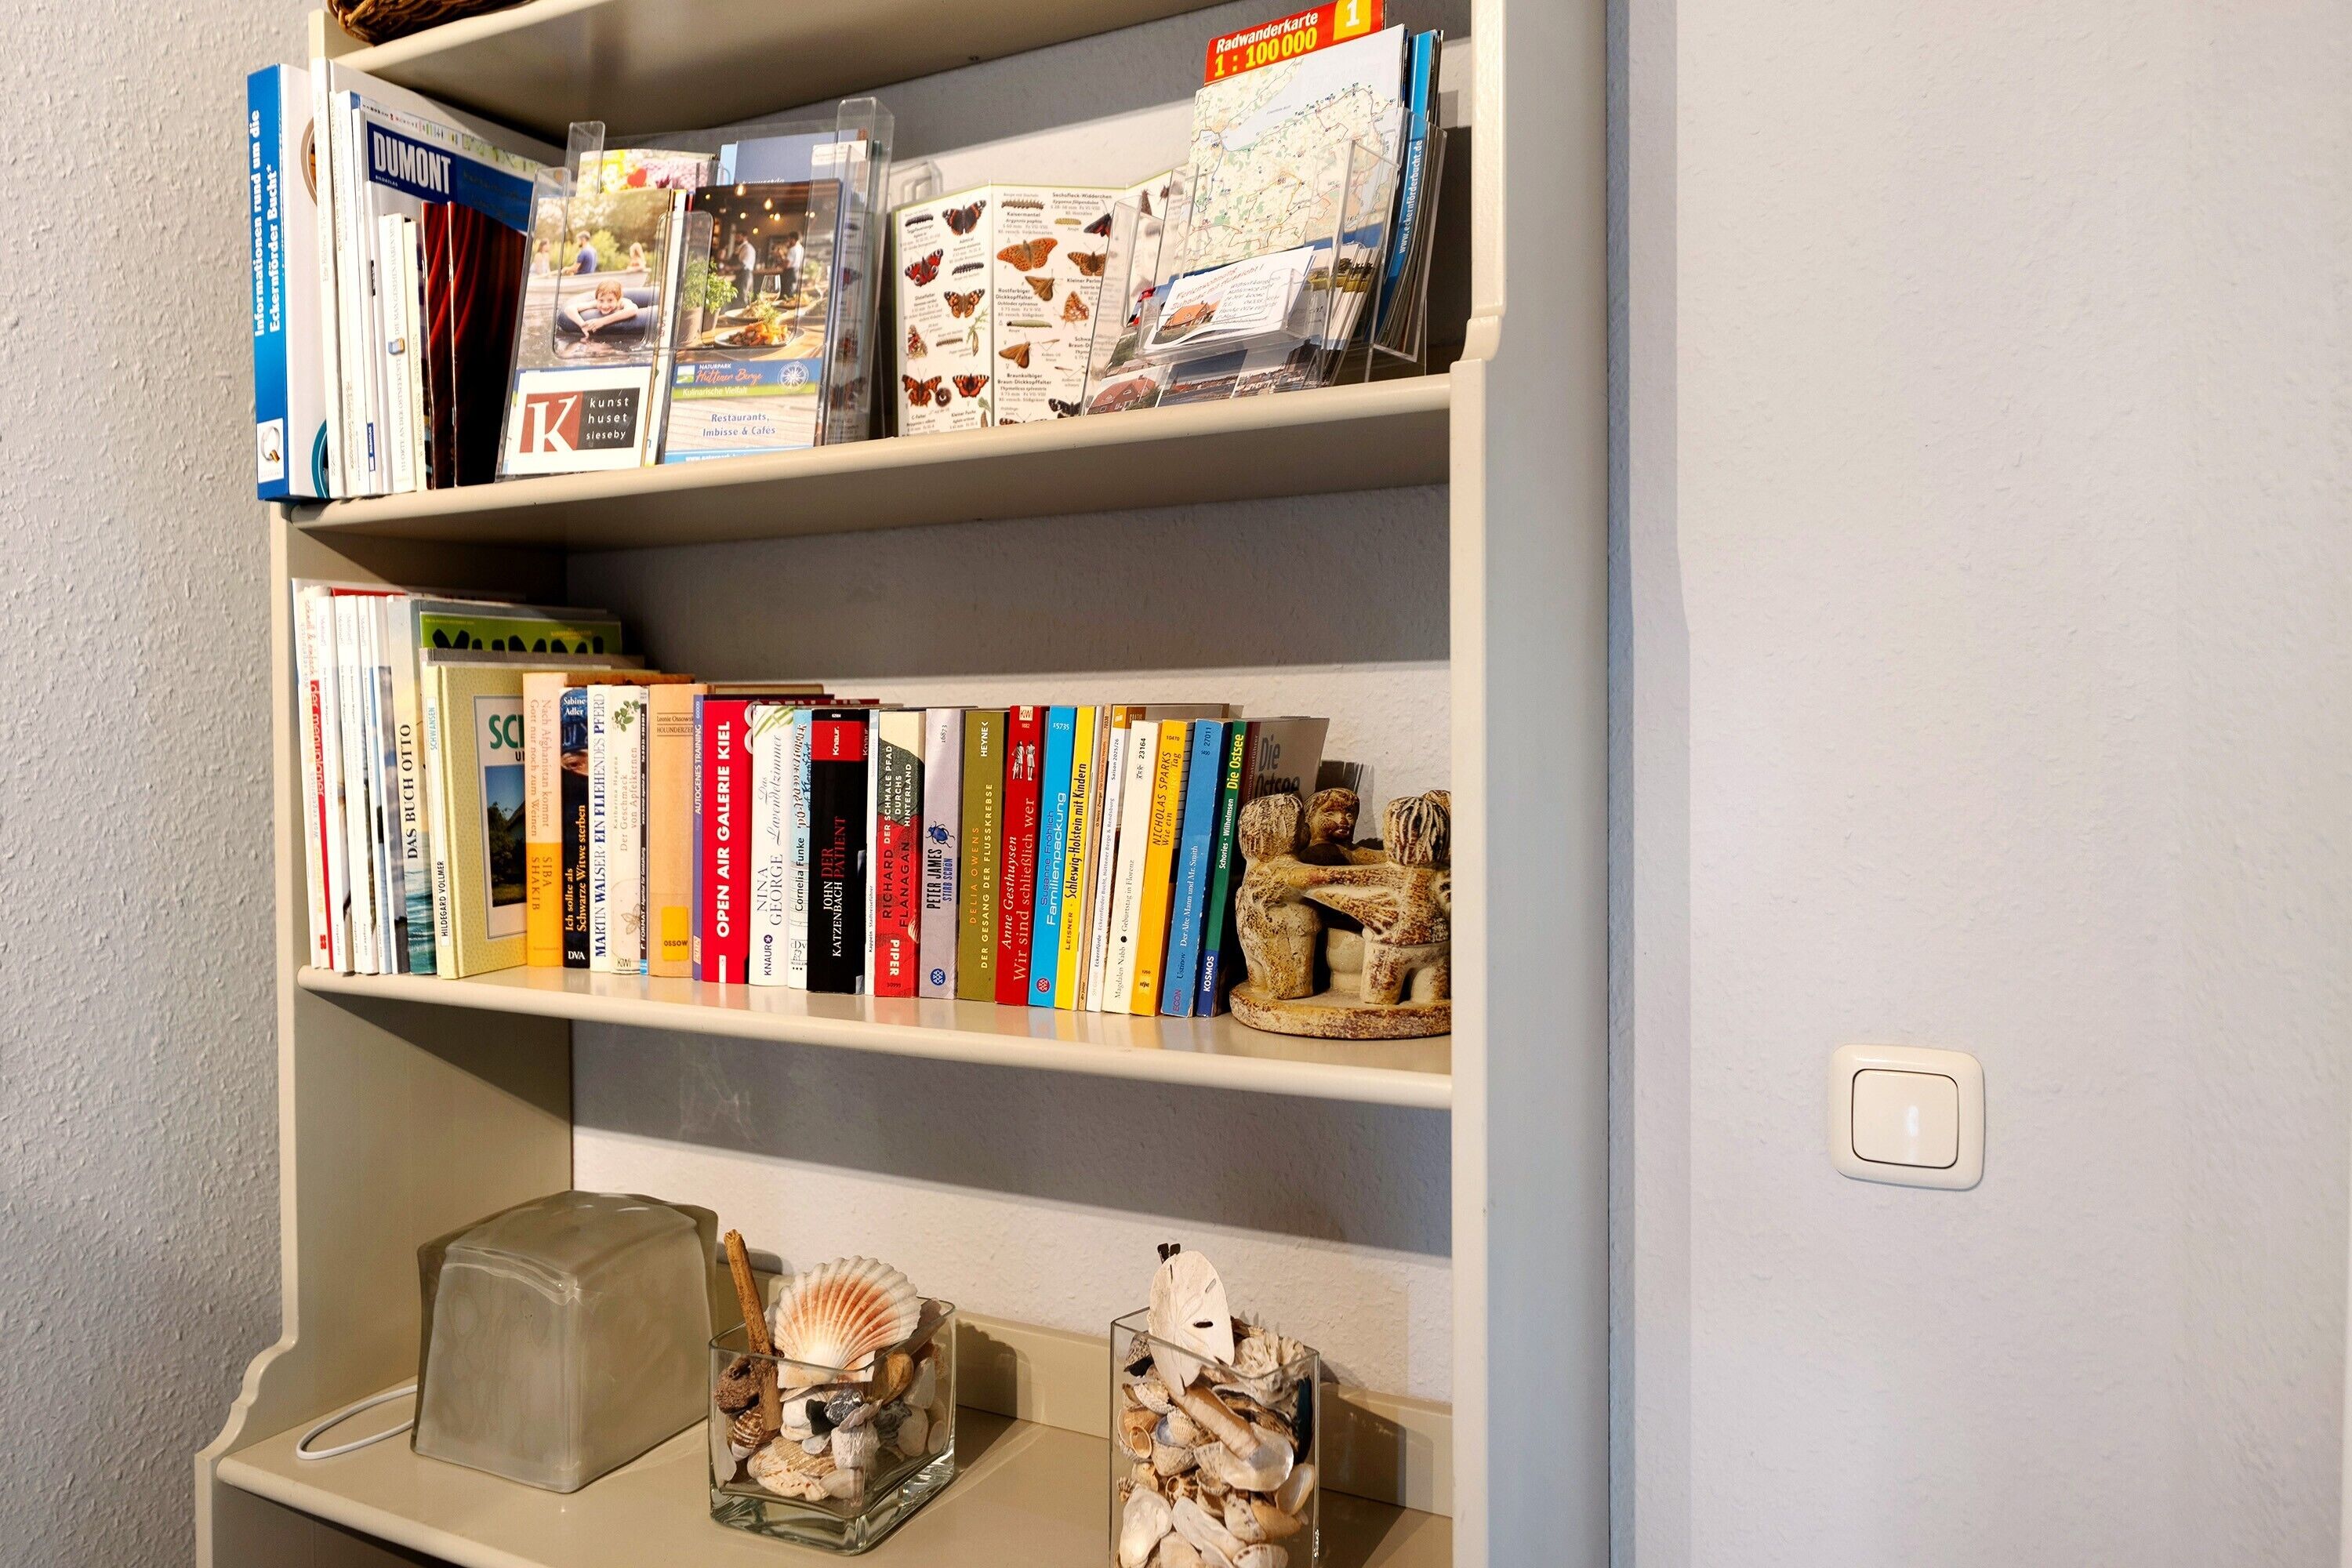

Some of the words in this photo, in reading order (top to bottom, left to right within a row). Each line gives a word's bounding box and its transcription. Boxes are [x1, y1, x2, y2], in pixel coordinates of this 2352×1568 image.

[1345, 0, 1359, 27] 1
[1216, 11, 1318, 53] Radwanderkarte
[1214, 54, 1225, 77] 1
[1246, 37, 1279, 68] 100
[1282, 27, 1318, 57] 000
[249, 110, 260, 137] die
[251, 141, 261, 169] um
[373, 131, 451, 194] DUMONT
[251, 172, 263, 212] rund
[376, 176, 397, 187] BILDATLAS
[1399, 140, 1422, 253] www.eckernförderbucht.de
[252, 216, 264, 336] Informationen
[266, 223, 281, 332] Eckernförder
[589, 412, 627, 423] huset
[590, 396, 629, 408] kunst
[711, 413, 770, 423] Restaurants,
[527, 395, 579, 455] K
[586, 430, 626, 441] sieseby
[703, 427, 738, 437] Imbisse
[428, 706, 438, 750] SCHWANSEN
[530, 700, 539, 722] Gott
[542, 699, 551, 724] Nach
[593, 694, 604, 735] PFERD
[399, 724, 413, 771] OTTO
[539, 728, 552, 788] Afghanistan
[717, 720, 730, 760] KIEL
[1228, 735, 1243, 768] Ostsee
[1258, 734, 1280, 771] Die
[530, 747, 539, 771] noch
[593, 738, 604, 816] FLIEHENDES
[629, 747, 638, 807] Apfelkernen
[1158, 751, 1171, 789] SPARKS
[757, 776, 768, 804] Das
[767, 735, 782, 846] Lavendelzimmer
[1073, 764, 1087, 798] Kindern
[1226, 771, 1240, 789] Die
[402, 778, 416, 822] BUCH
[542, 791, 552, 827] kommt
[620, 775, 629, 829] Geschmack
[717, 765, 730, 841] GALERIE
[1024, 797, 1034, 827] wer
[1073, 800, 1083, 815] mit
[1161, 829, 1171, 846] Wie
[1171, 753, 1181, 768] Tag
[1222, 798, 1234, 837] Wilhelmsen
[531, 799, 539, 837] Weinen
[576, 804, 586, 843] sterben
[595, 821, 605, 843] EIN
[983, 784, 993, 862] FLUSSKREBSE
[1044, 811, 1054, 854] Fröhlich
[1152, 794, 1167, 845] NICHOLAS
[405, 827, 418, 859] DAS
[797, 837, 805, 866] Funke
[834, 815, 846, 877] PATIENT
[1047, 792, 1066, 926] Familienpackung
[1065, 818, 1083, 899] Schleswig-Holstein
[1188, 846, 1198, 866] Smith
[1218, 843, 1228, 869] Schories
[437, 861, 446, 894] VOLLMER
[542, 857, 553, 887] SIBA
[565, 868, 574, 882] als
[576, 846, 586, 880] Witwe
[595, 850, 606, 903] WALSER
[717, 847, 730, 880] AIR
[822, 848, 833, 877] DER
[927, 848, 942, 879] JAMES
[942, 858, 953, 880] SCHÖN
[1004, 836, 1017, 911] Gesthuysen
[1020, 833, 1033, 905] schließlich
[1125, 859, 1134, 885] Florenz
[565, 885, 574, 910] sollte
[757, 868, 768, 913] NINA
[771, 854, 782, 926] GEORGE
[796, 870, 804, 911] Cornelia
[823, 881, 833, 909] JOHN
[881, 849, 894, 919] RICHARD
[898, 842, 910, 928] FLANAGAN
[927, 882, 941, 909] PETER
[942, 882, 952, 902] STIRB
[1040, 858, 1051, 906] Susanne
[438, 896, 448, 936] HILDEGARD
[565, 914, 574, 931] Ich
[575, 883, 586, 931] Schwarze
[717, 884, 730, 937] OPEN
[832, 882, 843, 957] KATZENBACH
[981, 894, 989, 941] GESANG
[1120, 895, 1131, 932] Geburtstag
[1183, 896, 1192, 916] Mann
[595, 907, 606, 957] MARTIN
[1002, 914, 1013, 949] Anne
[1014, 910, 1029, 945] sind
[1065, 912, 1074, 951] LEISNER
[1180, 932, 1189, 946] Der
[568, 949, 585, 958] DVA
[889, 939, 900, 975] PIPER
[1013, 948, 1027, 981] Wir
[1117, 946, 1126, 964] Nabb
[1177, 953, 1186, 979] Ustinov
[1116, 967, 1125, 998] Magdalen
[1203, 956, 1214, 992] KOSMOS
[1173, 989, 1181, 1011] ECON
